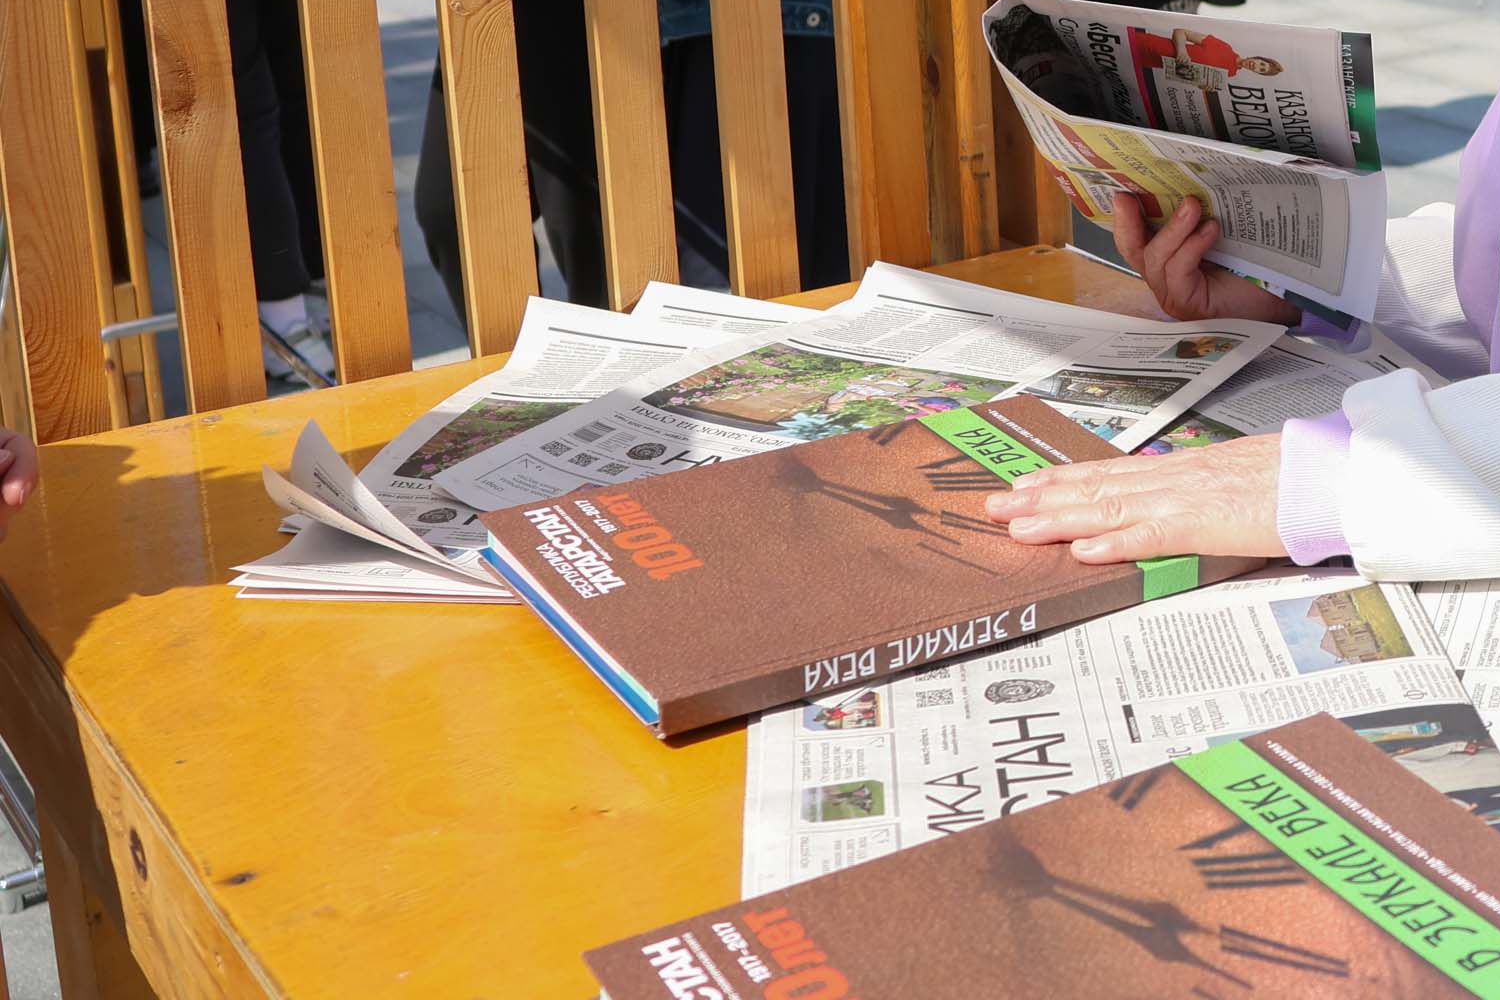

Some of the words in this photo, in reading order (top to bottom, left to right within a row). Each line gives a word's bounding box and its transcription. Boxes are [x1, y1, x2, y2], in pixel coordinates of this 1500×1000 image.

[954, 428, 1028, 464] ВЕКА
[574, 500, 617, 533] 1917-2017
[523, 507, 627, 594] ТАТАРСТАН
[536, 542, 600, 599] РЕСПУБЛИКА
[888, 610, 1010, 669] ЗЕРКАЛЕ
[1019, 603, 1037, 633] В
[804, 647, 876, 692] ВЕКА
[1224, 773, 1328, 838] ВЕКА
[1306, 834, 1478, 948] ЗЕРКАЛЕ
[712, 922, 772, 983] 1917-2017
